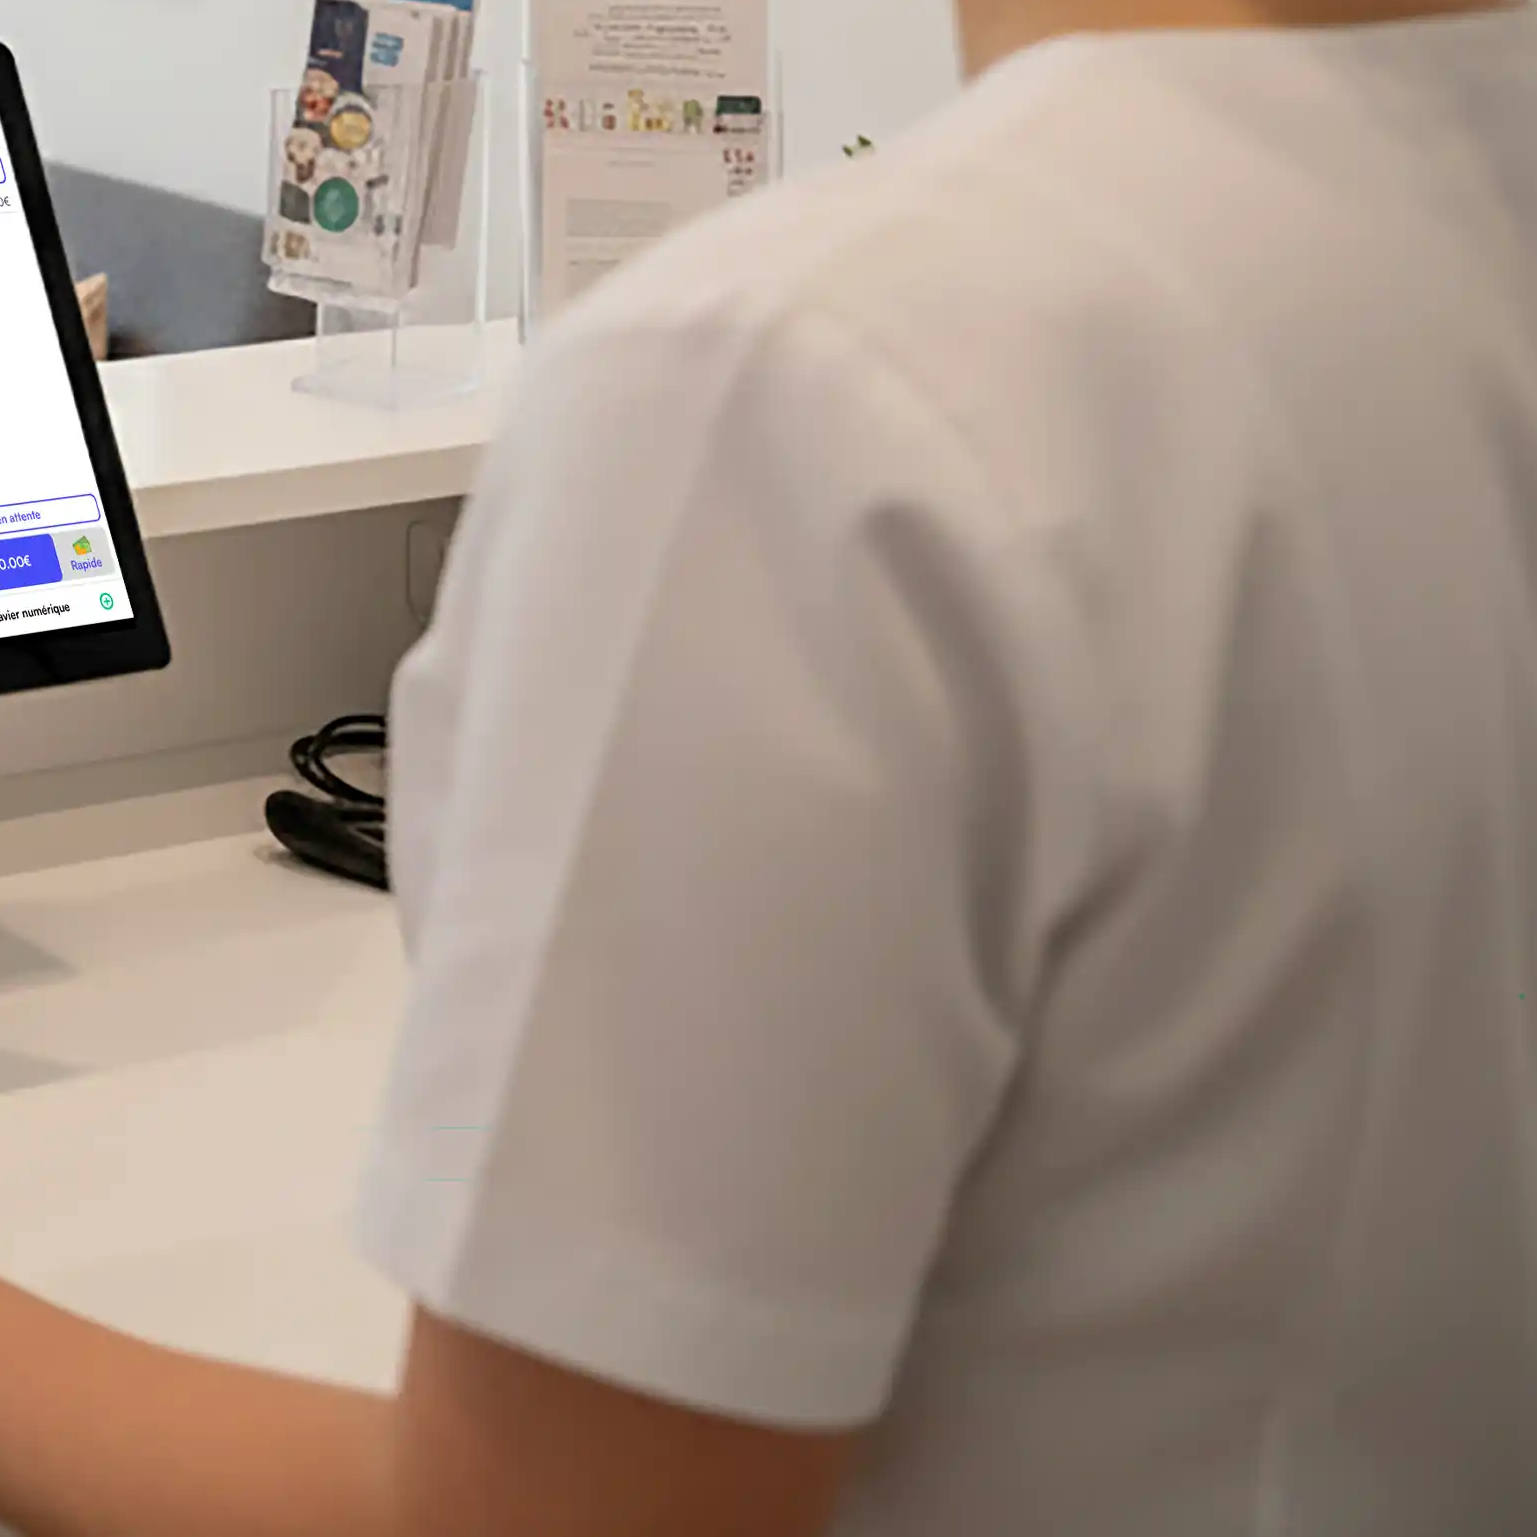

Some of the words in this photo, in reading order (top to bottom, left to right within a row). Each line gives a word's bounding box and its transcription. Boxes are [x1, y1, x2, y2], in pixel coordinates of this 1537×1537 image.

[10, 511, 41, 525] attente
[71, 558, 103, 573] Rapide
[22, 603, 70, 619] numérique
